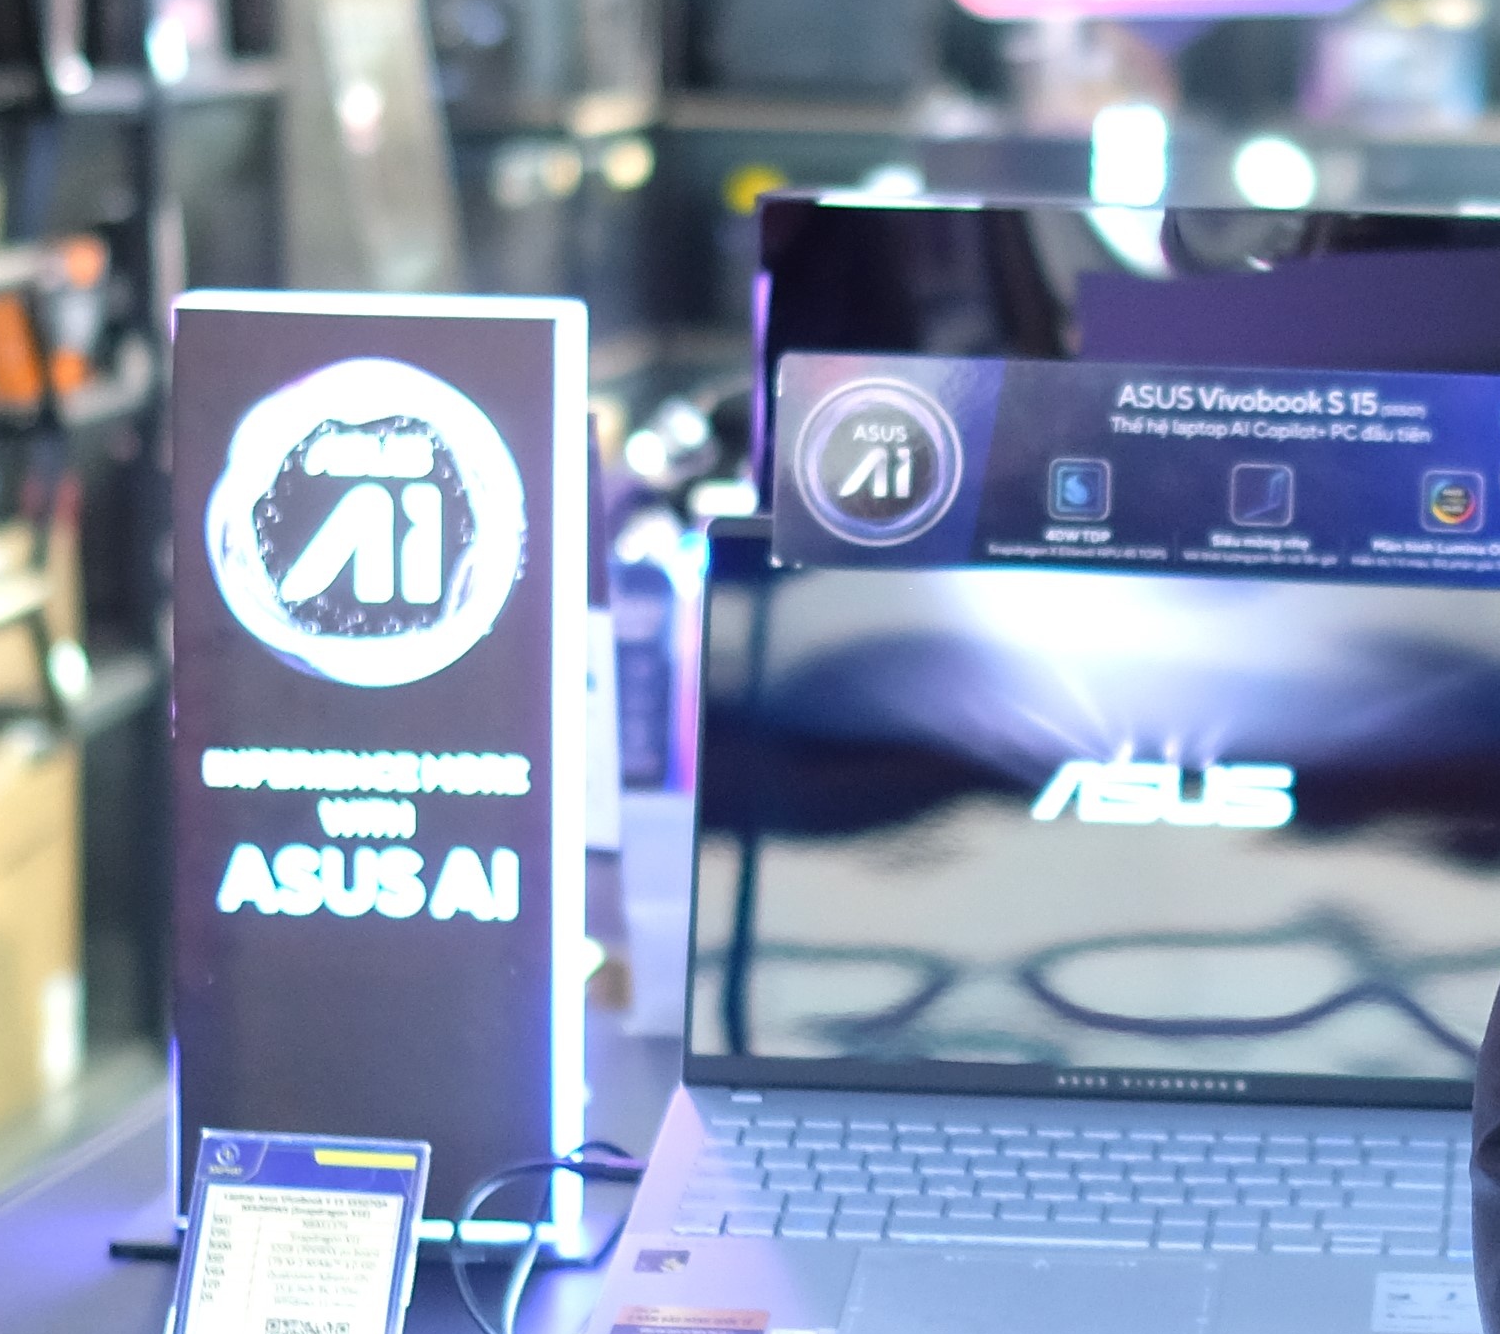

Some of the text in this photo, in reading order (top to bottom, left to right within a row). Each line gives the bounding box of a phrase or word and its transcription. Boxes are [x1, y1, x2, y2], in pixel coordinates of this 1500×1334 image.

[1117, 384, 1195, 411] ASUS
[1198, 385, 1323, 415] Vivobook
[1327, 390, 1345, 415] S
[1350, 391, 1378, 416] 15
[852, 424, 908, 443] ASUS
[1172, 419, 1229, 440] laptop
[1330, 423, 1357, 441] PC
[1030, 760, 1297, 828] ASUS
[215, 842, 521, 922] ASUS AI
[1056, 1074, 1108, 1087] ASUS
[1121, 1077, 1229, 1091] VIVOBOOK
